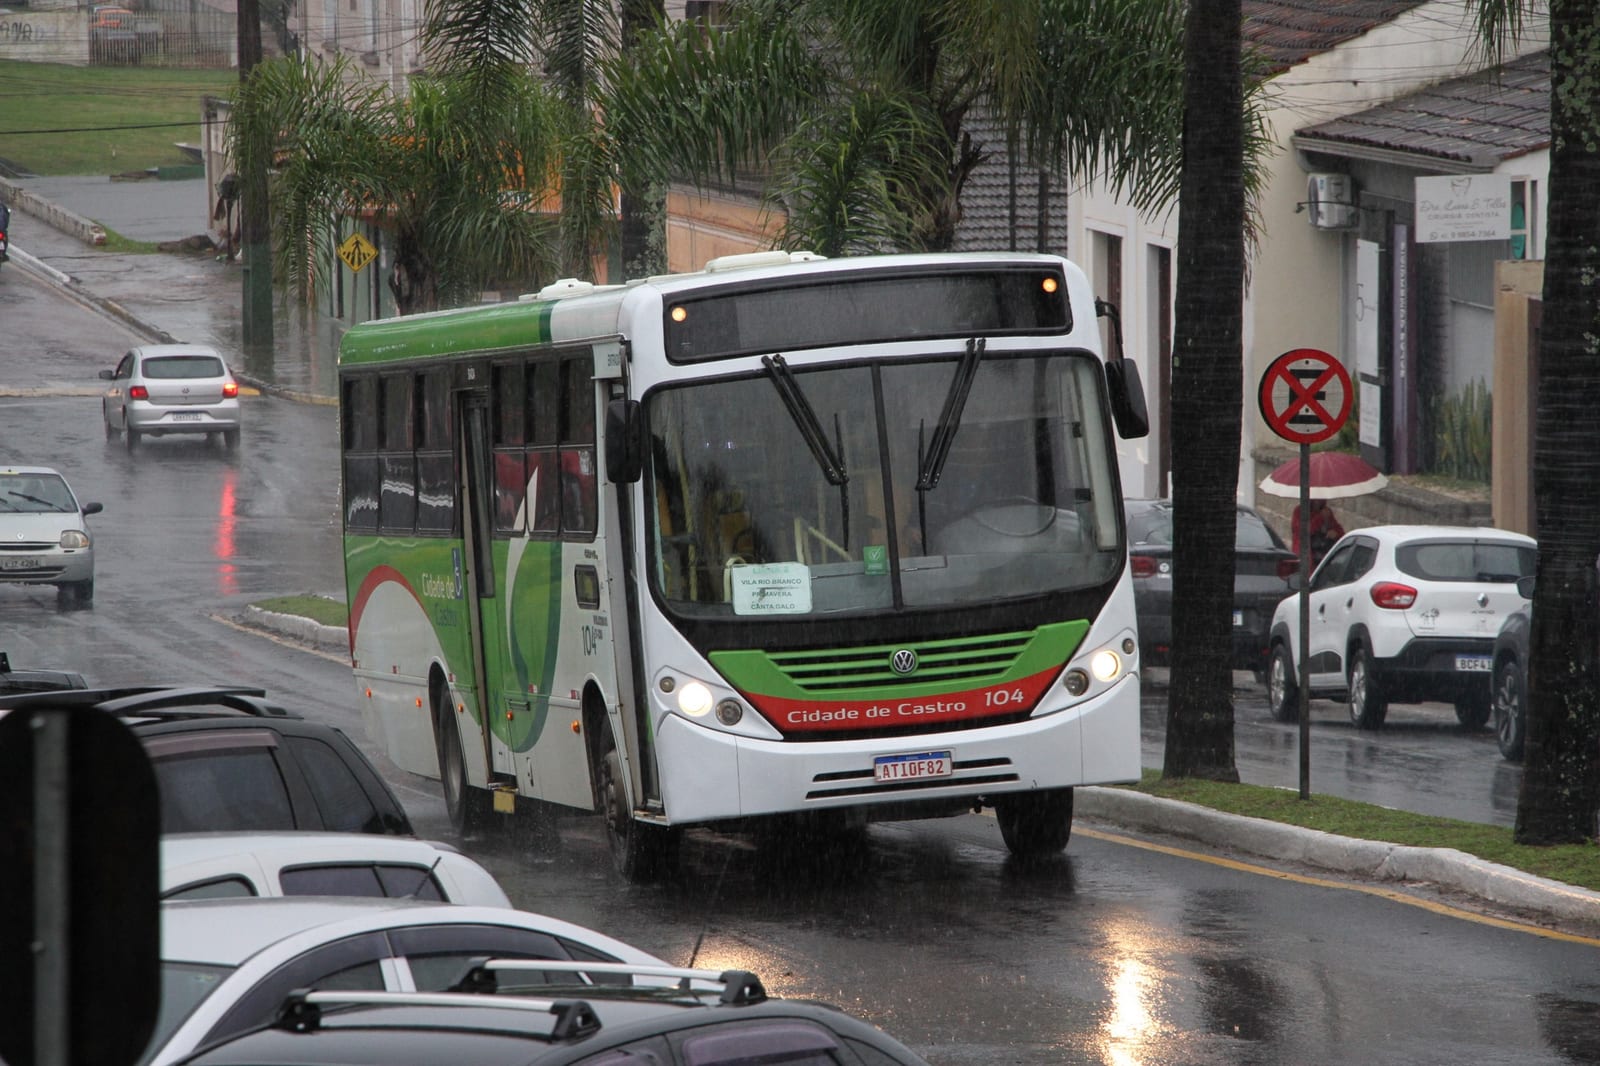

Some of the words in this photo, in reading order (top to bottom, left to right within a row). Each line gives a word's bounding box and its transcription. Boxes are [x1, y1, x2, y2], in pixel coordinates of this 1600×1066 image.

[422, 573, 445, 598] Cidade
[446, 575, 455, 600] de
[582, 625, 597, 656] 104
[787, 708, 859, 723] Cidade
[865, 705, 891, 719] de
[897, 702, 966, 716] Castro
[984, 689, 1024, 707] 104
